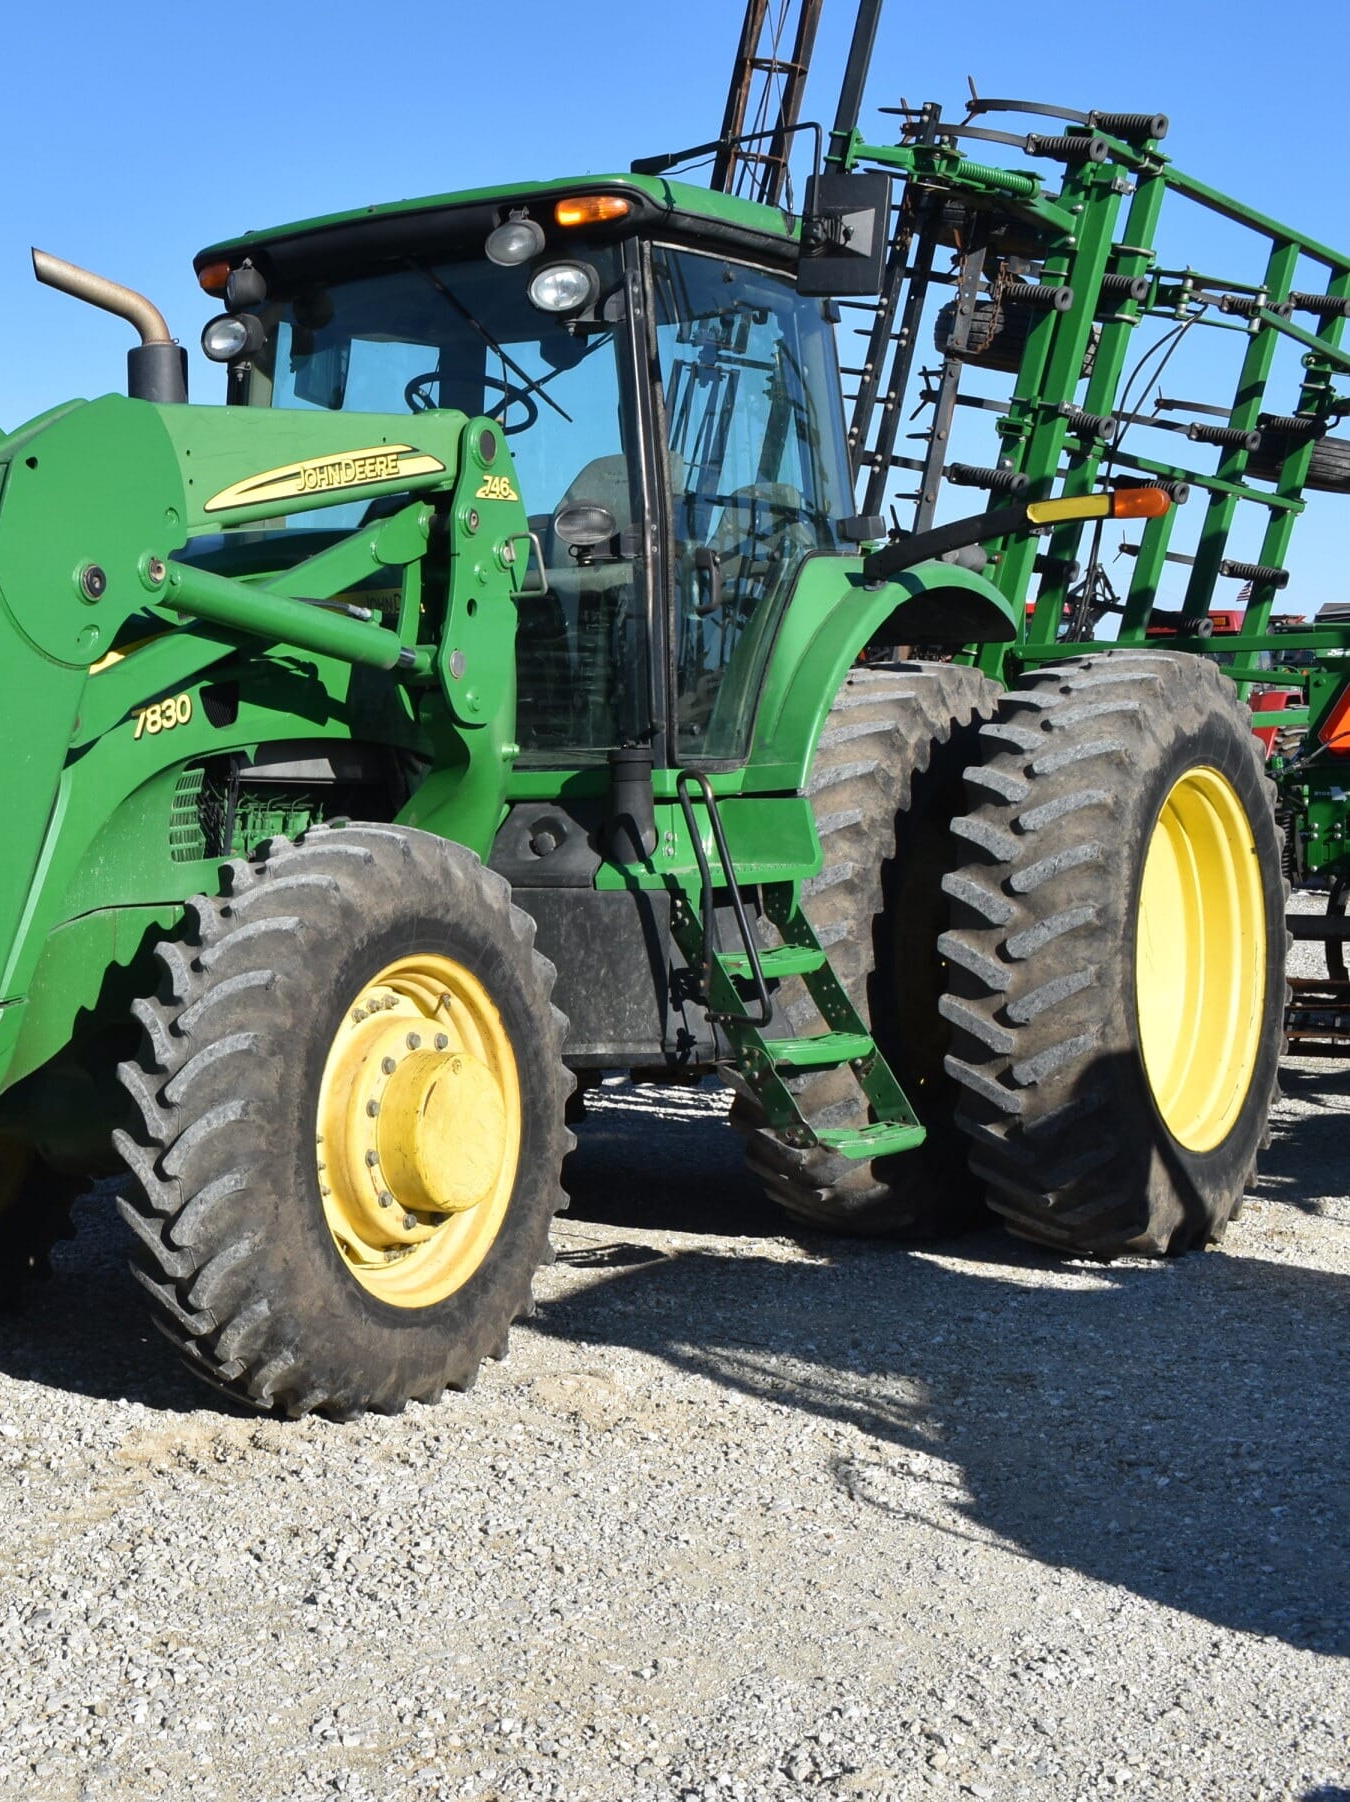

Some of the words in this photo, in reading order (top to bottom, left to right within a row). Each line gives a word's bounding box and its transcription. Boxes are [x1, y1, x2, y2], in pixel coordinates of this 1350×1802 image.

[296, 464, 342, 491] JOHN
[340, 454, 400, 483] DEERE
[482, 474, 511, 498] 746
[131, 693, 192, 741] 7830
